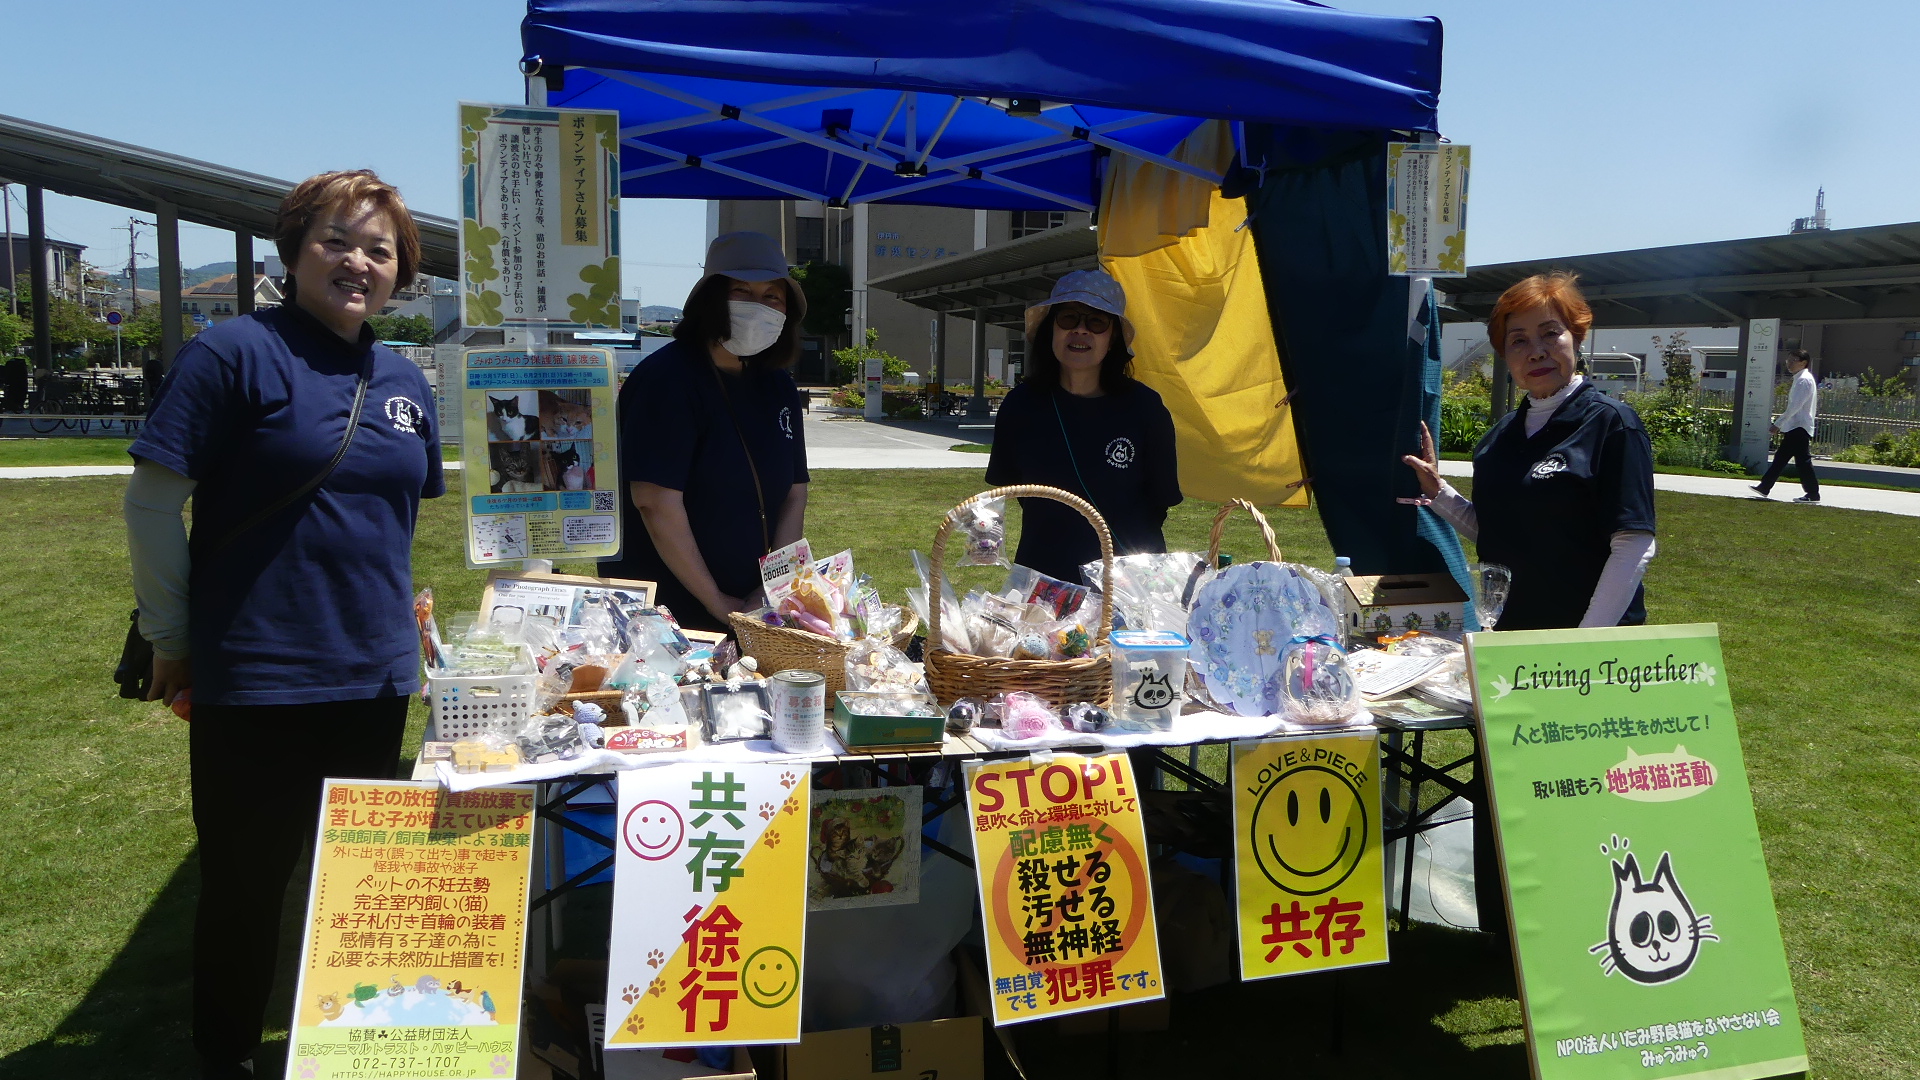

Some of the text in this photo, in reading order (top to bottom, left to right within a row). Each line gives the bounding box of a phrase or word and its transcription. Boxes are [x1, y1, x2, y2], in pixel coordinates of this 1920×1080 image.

[572, 116, 588, 242] ボランティアさん募集
[1442, 147, 1453, 222] ボランティアさん募集
[876, 246, 960, 260] 防災センター
[763, 564, 790, 582] COOKIE
[512, 584, 550, 592] Photograph
[1511, 654, 1700, 696] Living Together
[1512, 714, 1711, 746] 人と猫たちの共生をめざして!
[1247, 748, 1368, 797] LOVE&PIECE
[1534, 760, 1714, 800] 取り組もう 地域猫活動
[328, 787, 534, 810] 飼い主の放任/責務放棄で
[974, 760, 1126, 814] STOP!
[330, 810, 529, 830] 苦しむ子が増えています
[975, 798, 1136, 832] 息吹く命と環境に対して
[324, 828, 530, 848] 多頭飼育/飼育放棄による遺棄
[1008, 822, 1114, 858] 配慮無く
[332, 846, 518, 862] 外に出す(誤って出た)事で起きる
[373, 860, 478, 874] 怪我や事故や迷子
[1017, 852, 1111, 894] 殺せる
[356, 874, 490, 894] ペットの不妊去勢
[354, 894, 488, 913] 完全室内飼い(猫)
[677, 771, 747, 1033] 共存 徐行
[1021, 886, 1115, 929] 汚せる
[330, 913, 507, 931] 迷子札付き首輪の装着
[1261, 896, 1366, 964] 共存
[340, 932, 496, 950] 感情有る子達の為に
[1024, 919, 1124, 966] 無神経
[326, 950, 504, 969] 必要な未然防止措置を!
[1556, 1008, 1781, 1056] NPO法人いたみ野良猫をふやさない会
[298, 1040, 512, 1057] 日本アニマルトラスト・ハッピーハウス
[1640, 1042, 1710, 1068] みゅうみゅう
[332, 1069, 476, 1080] HTTPS://HAPPYHOUSE.OR.JP
[352, 1056, 460, 1070] 072-737-1707
